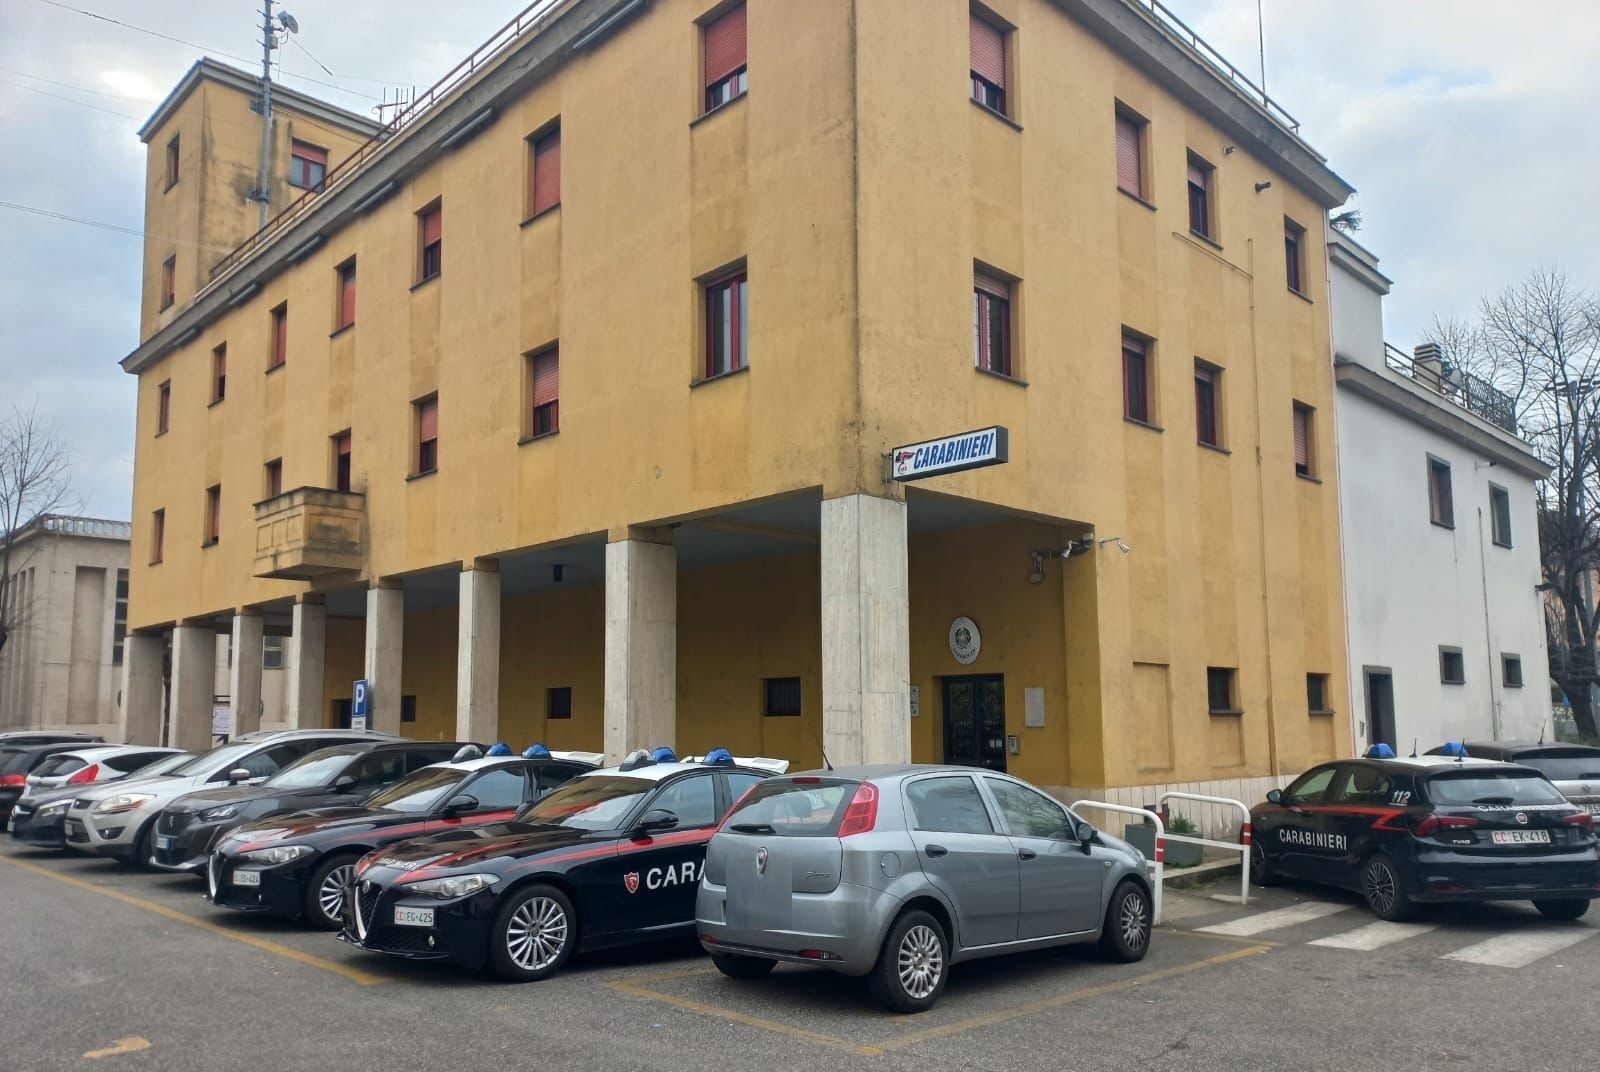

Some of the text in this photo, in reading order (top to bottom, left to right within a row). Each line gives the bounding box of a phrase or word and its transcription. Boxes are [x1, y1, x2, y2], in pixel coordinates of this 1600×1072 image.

[913, 432, 995, 469] CARABINIERI
[355, 684, 365, 714] P
[1391, 790, 1411, 804] 112
[1279, 828, 1347, 851] CARABINIERI
[1494, 831, 1509, 842] CC
